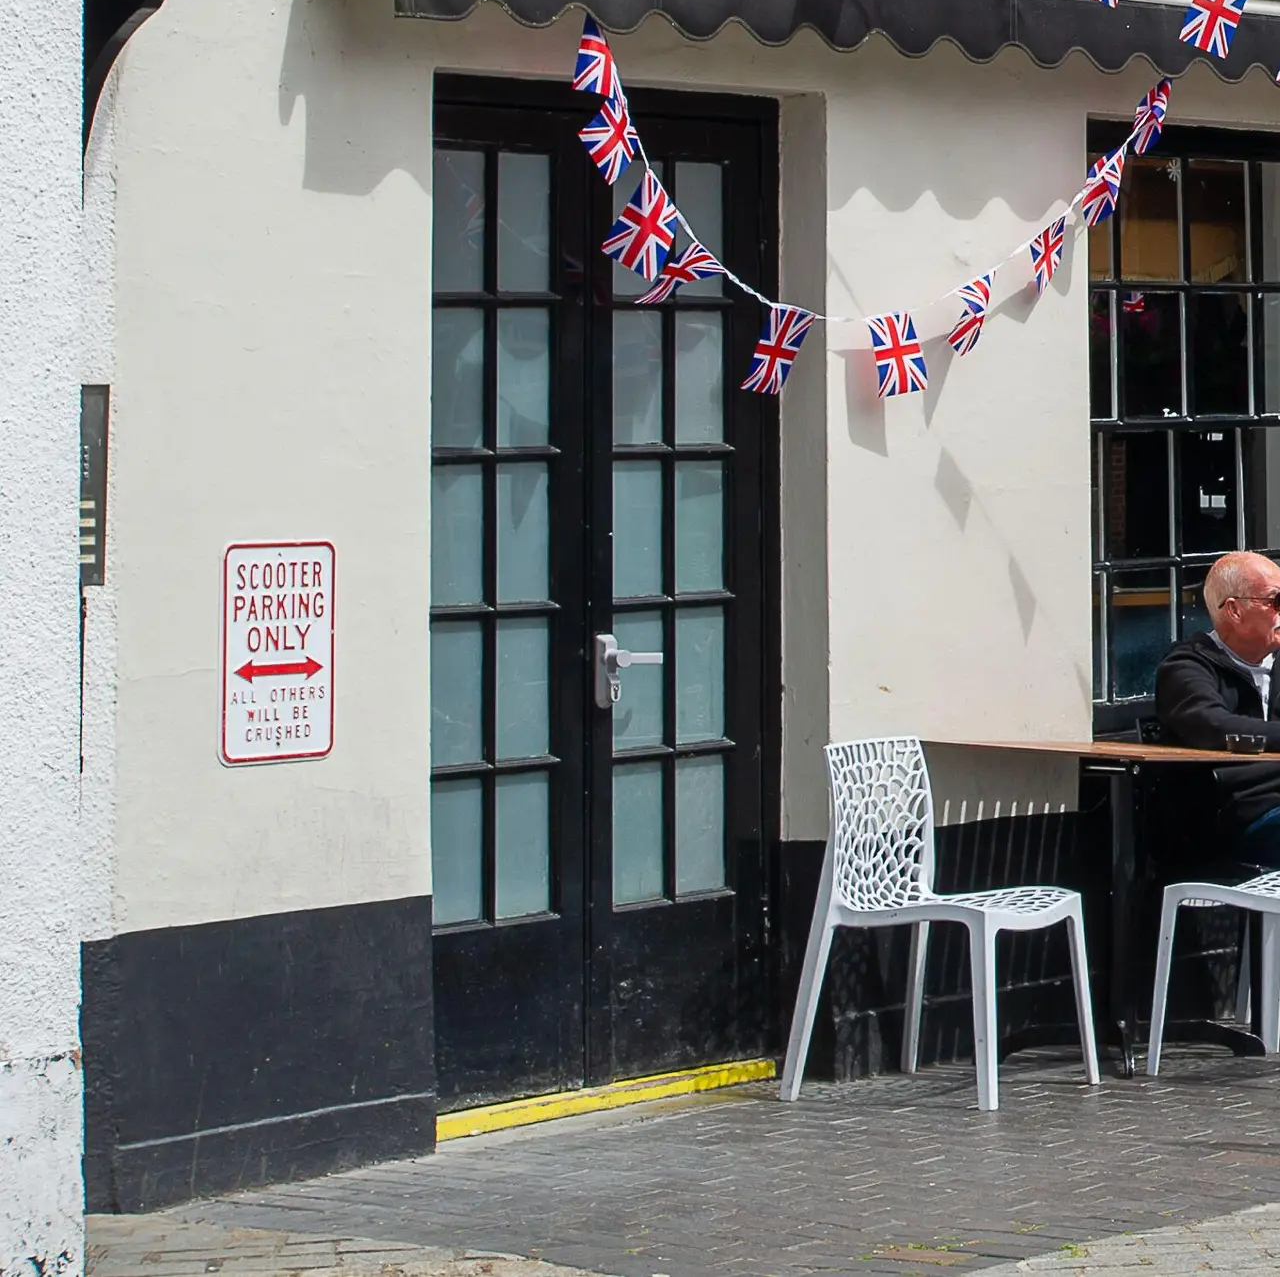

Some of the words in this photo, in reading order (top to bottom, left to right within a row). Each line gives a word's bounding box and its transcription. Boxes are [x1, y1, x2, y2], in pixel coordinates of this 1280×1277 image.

[236, 561, 323, 591] SCOOTER
[233, 591, 325, 623] PARKING
[247, 624, 311, 652] ONLY
[230, 691, 258, 705] ALL
[270, 685, 326, 702] OTHERS
[247, 707, 280, 723] WILL
[292, 705, 309, 719] BE
[245, 724, 312, 743] CRUSHED
